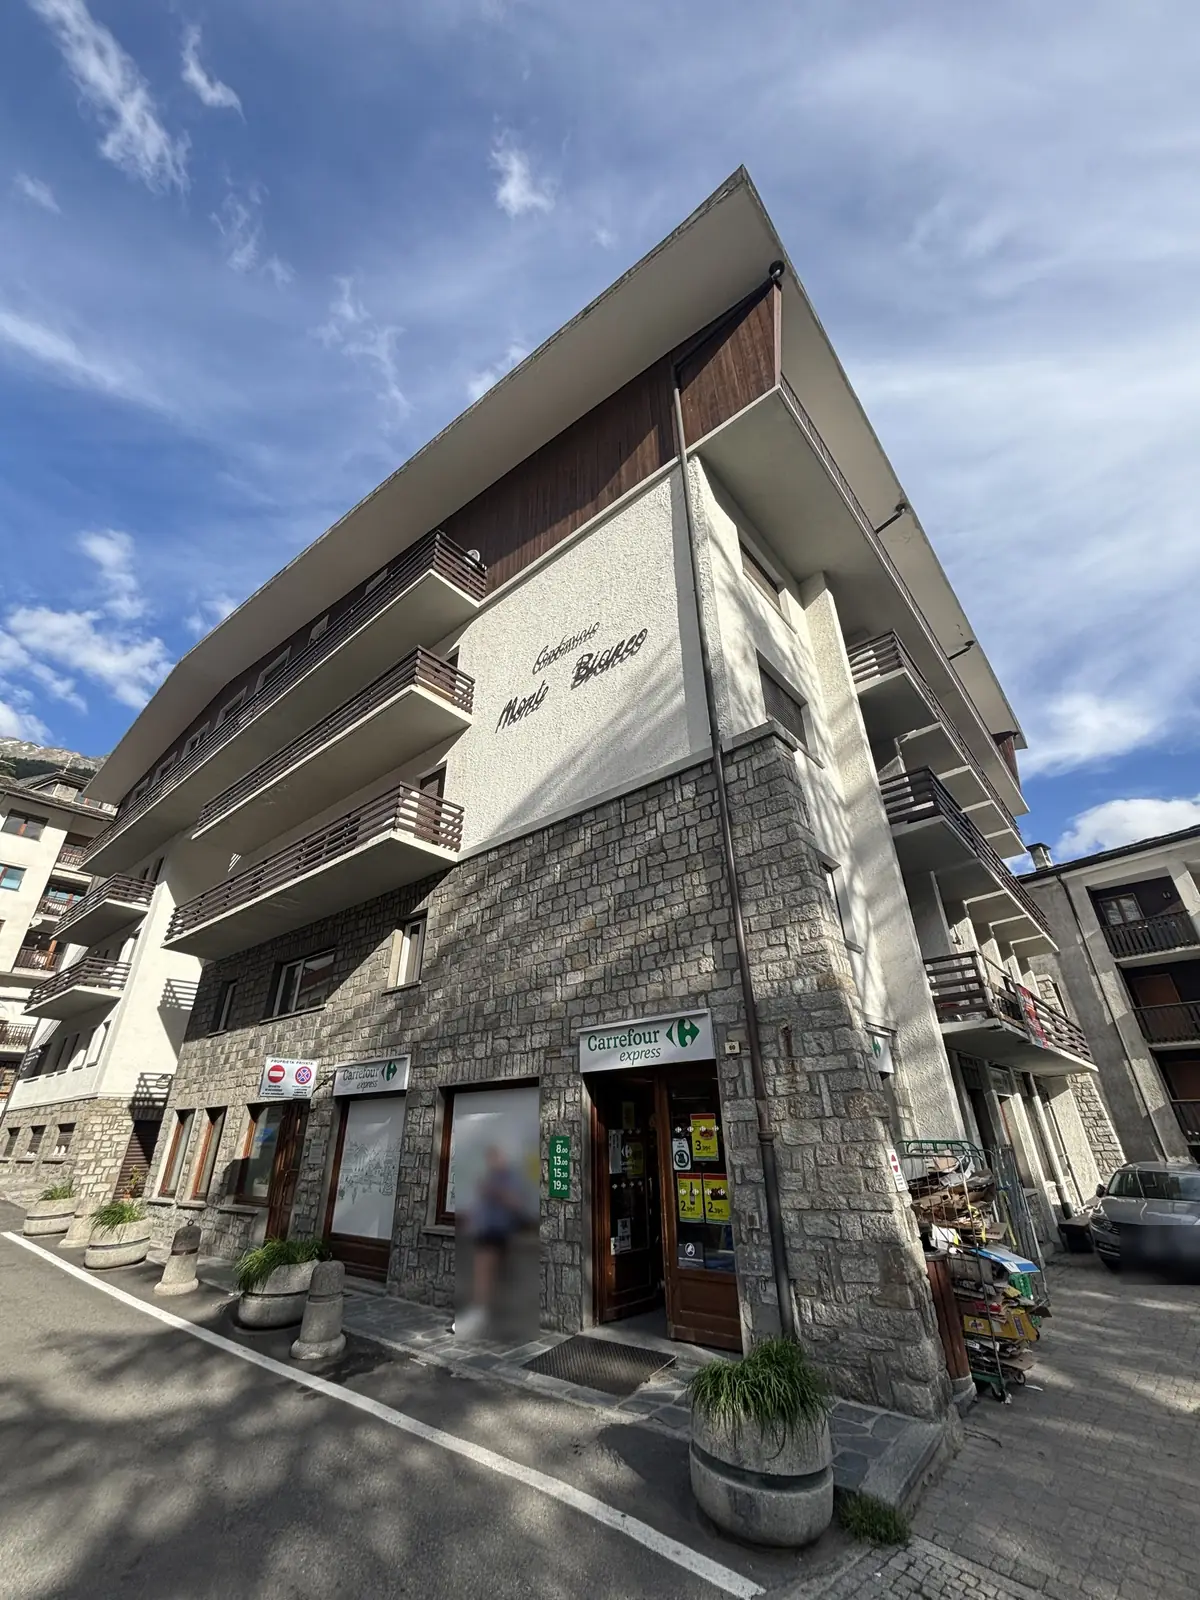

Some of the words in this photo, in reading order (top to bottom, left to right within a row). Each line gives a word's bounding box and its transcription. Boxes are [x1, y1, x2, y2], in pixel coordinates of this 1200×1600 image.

[495, 679, 549, 733] Monte
[570, 628, 648, 690] Bianco
[587, 1028, 660, 1051] Carrefour
[619, 1047, 662, 1065] express
[342, 1066, 380, 1081] Carrefour
[356, 1080, 379, 1092] express
